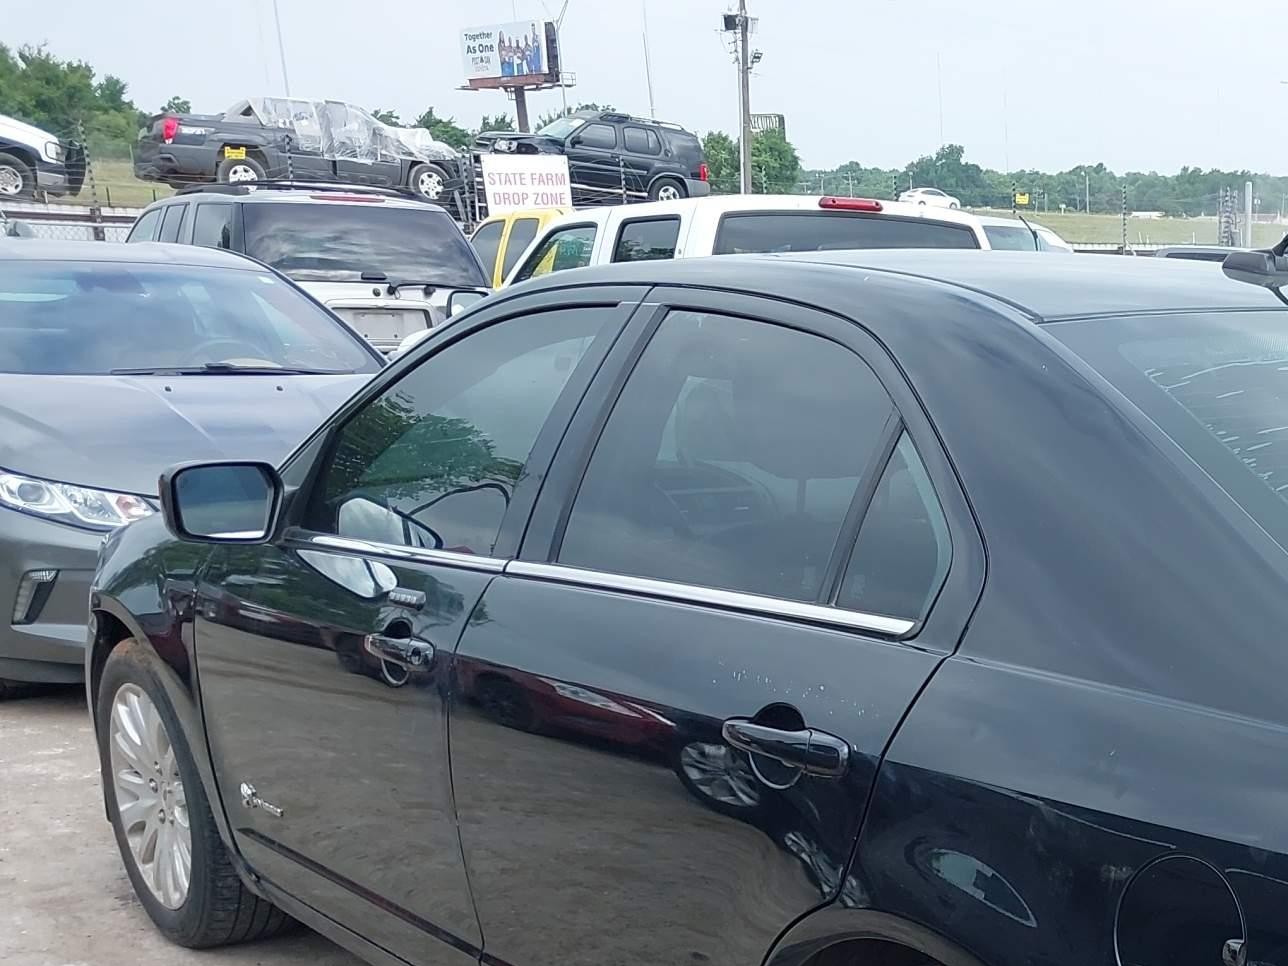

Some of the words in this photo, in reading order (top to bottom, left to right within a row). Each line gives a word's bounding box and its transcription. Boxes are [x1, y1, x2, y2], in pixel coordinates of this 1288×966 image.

[464, 32, 493, 42] Together
[466, 45, 477, 54] As
[478, 43, 494, 53] One
[487, 172, 526, 186] STATE
[531, 172, 566, 186] FARM
[493, 192, 529, 206] DROP
[533, 192, 566, 206] ZONE
